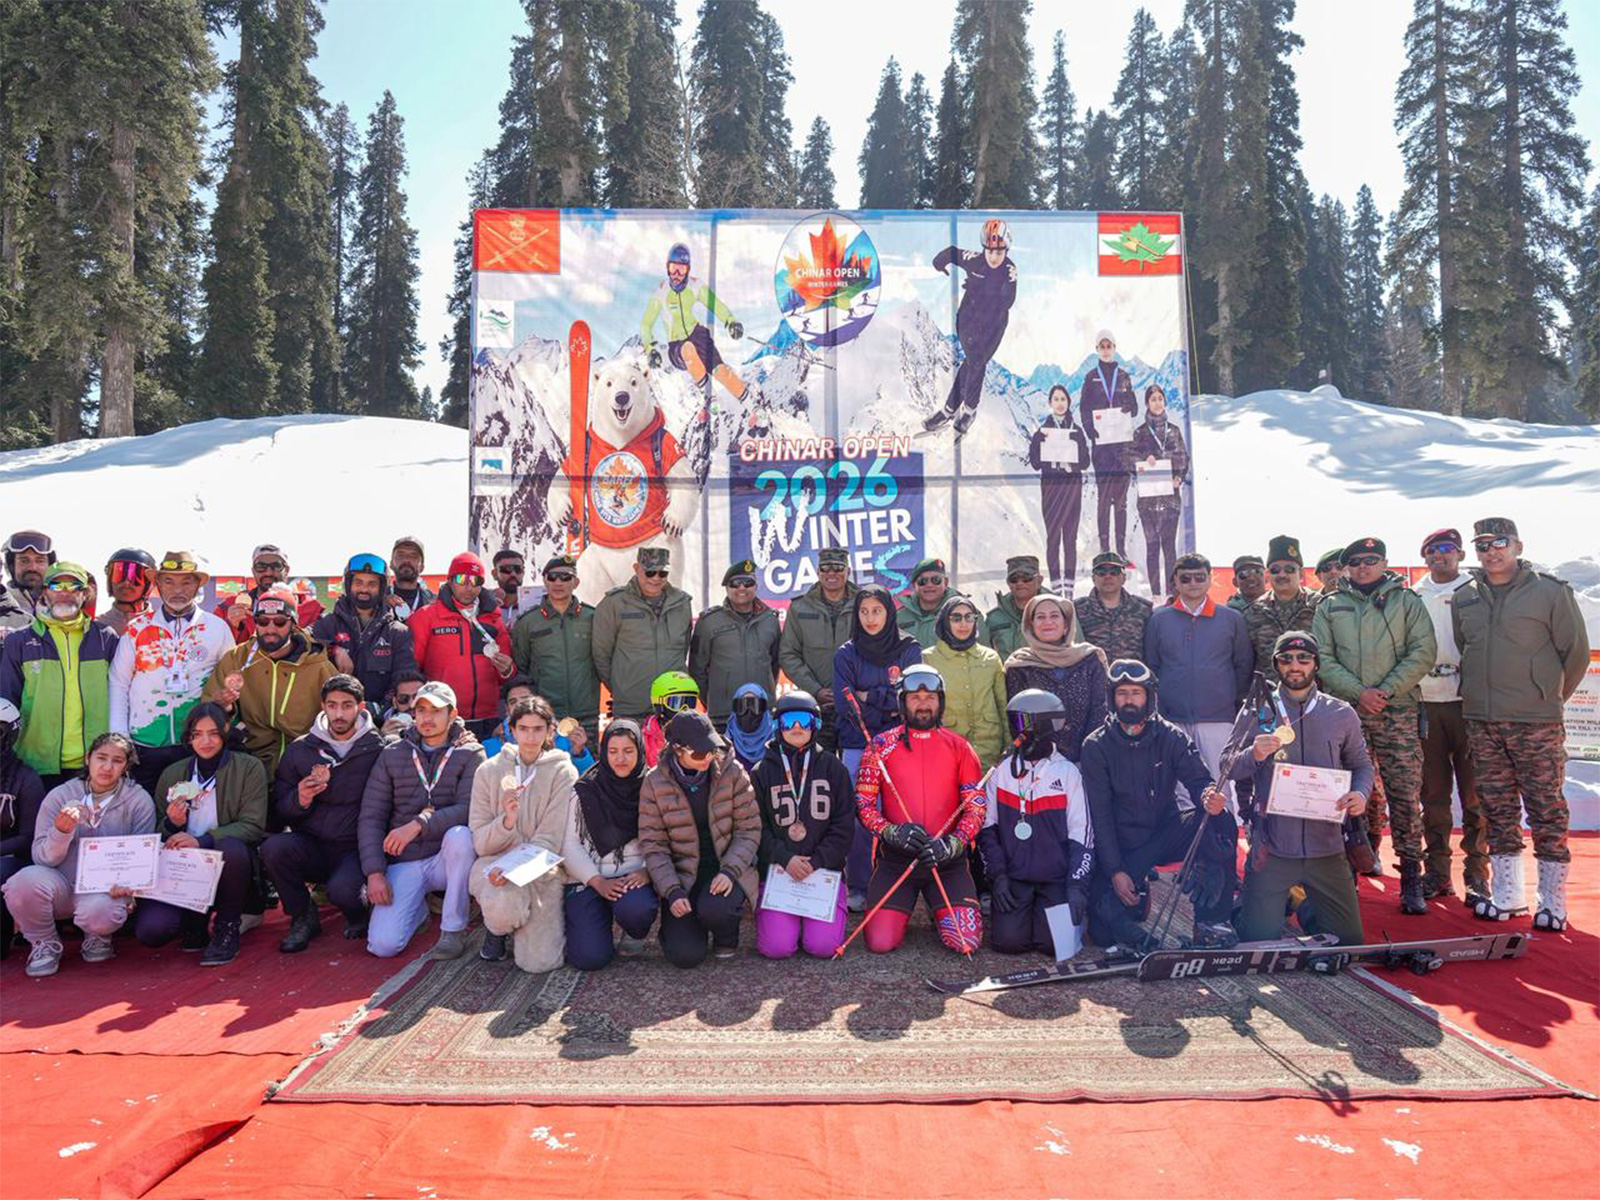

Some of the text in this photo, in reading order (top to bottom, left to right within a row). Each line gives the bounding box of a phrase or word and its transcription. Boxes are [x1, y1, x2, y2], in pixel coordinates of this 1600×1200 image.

[795, 268, 861, 278] CHINAR OPEN
[739, 435, 911, 462] CHINAR OPEN
[753, 457, 899, 521] 2026
[748, 488, 917, 569] WINTER
[763, 544, 912, 595] GAES
[1170, 954, 1243, 978] peak 88
[1449, 949, 1485, 958] HEAD
